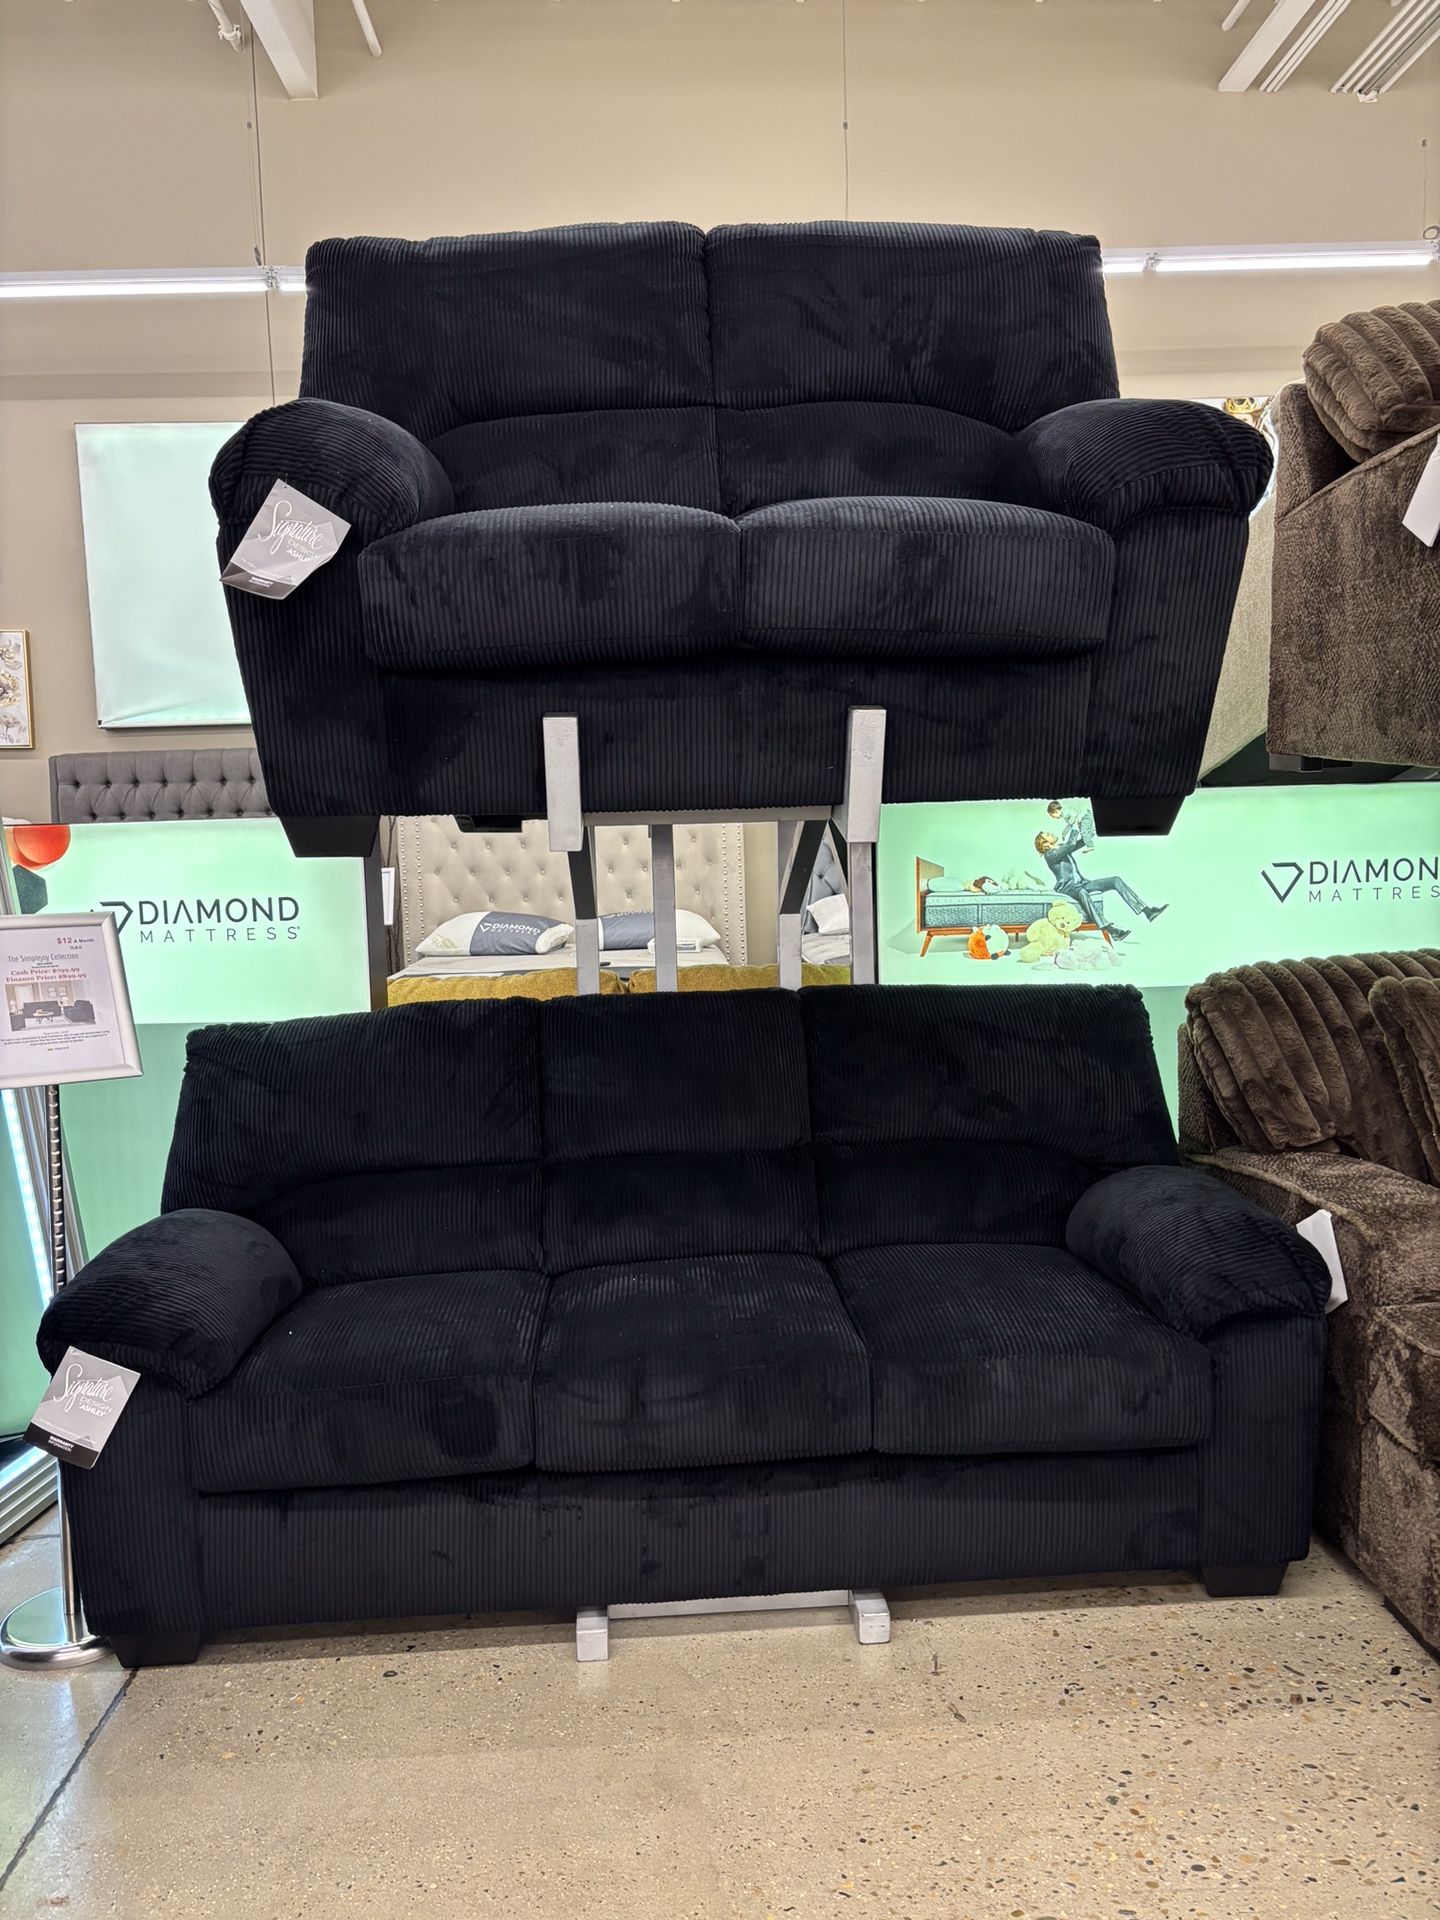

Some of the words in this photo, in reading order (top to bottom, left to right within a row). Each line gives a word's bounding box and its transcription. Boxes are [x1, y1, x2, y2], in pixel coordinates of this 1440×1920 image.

[258, 499, 324, 555] Signature
[1309, 856, 1440, 885] DIAMON
[1308, 885, 1440, 903] MATTRES
[138, 896, 300, 925] DIAMOND
[56, 936, 73, 945] $12
[139, 926, 299, 943] MATTRESS
[8, 953, 19, 963] The
[50, 952, 80, 961] Collection
[53, 1363, 115, 1413] Signature
